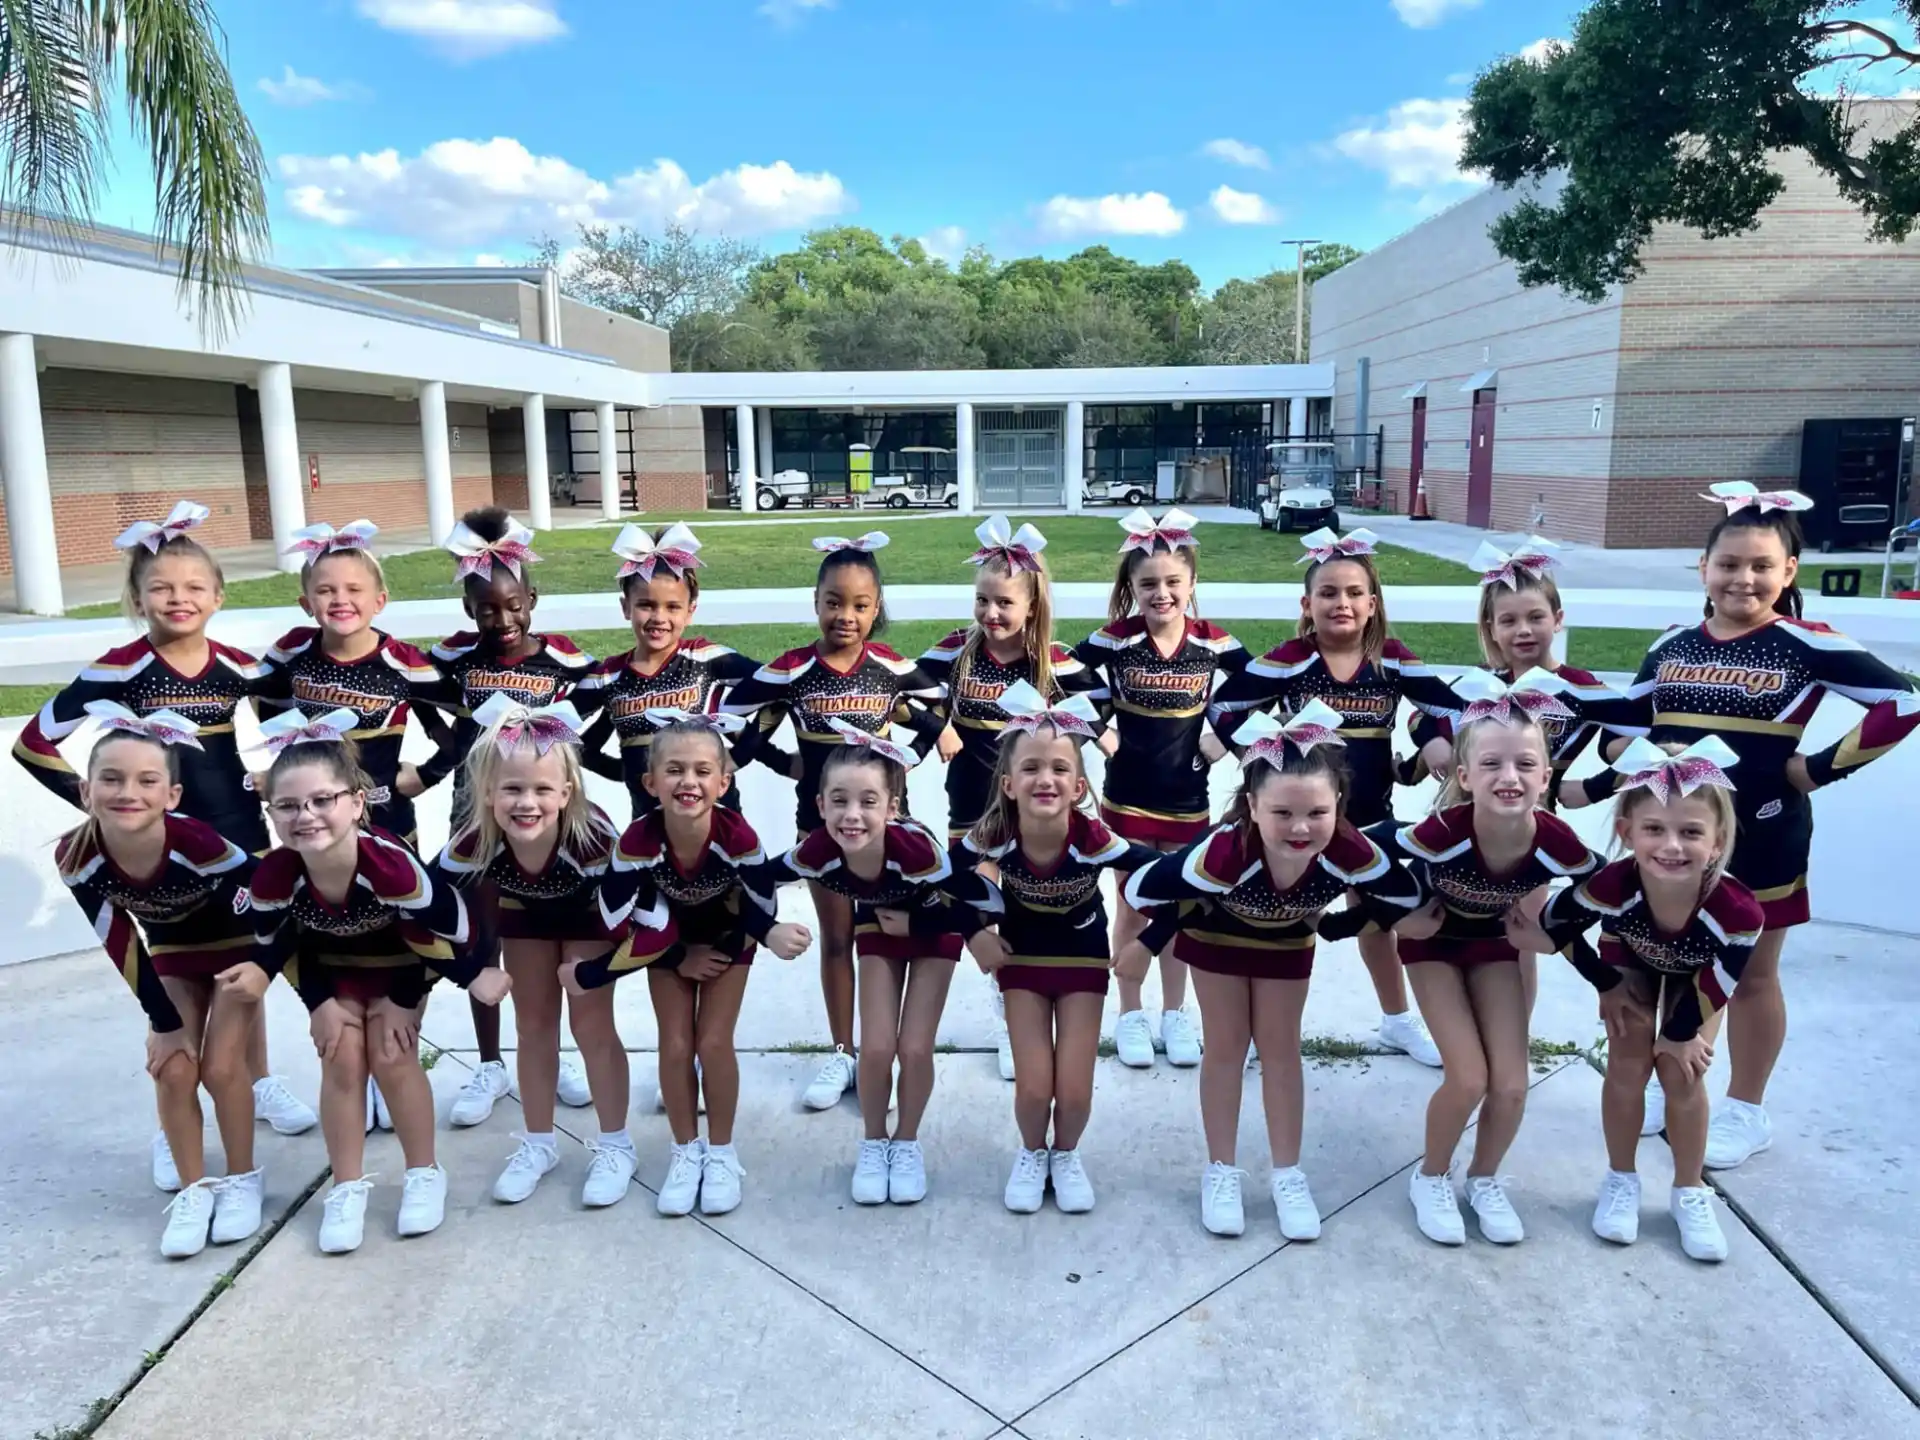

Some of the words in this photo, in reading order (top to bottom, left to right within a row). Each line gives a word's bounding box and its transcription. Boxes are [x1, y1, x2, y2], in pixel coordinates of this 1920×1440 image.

[1594, 407, 1601, 428] 7
[467, 670, 554, 695] Mustangs
[962, 679, 1006, 699] Must
[1125, 668, 1208, 693] Mustang
[1659, 662, 1782, 695] Mustangs
[805, 694, 889, 716] Mustang
